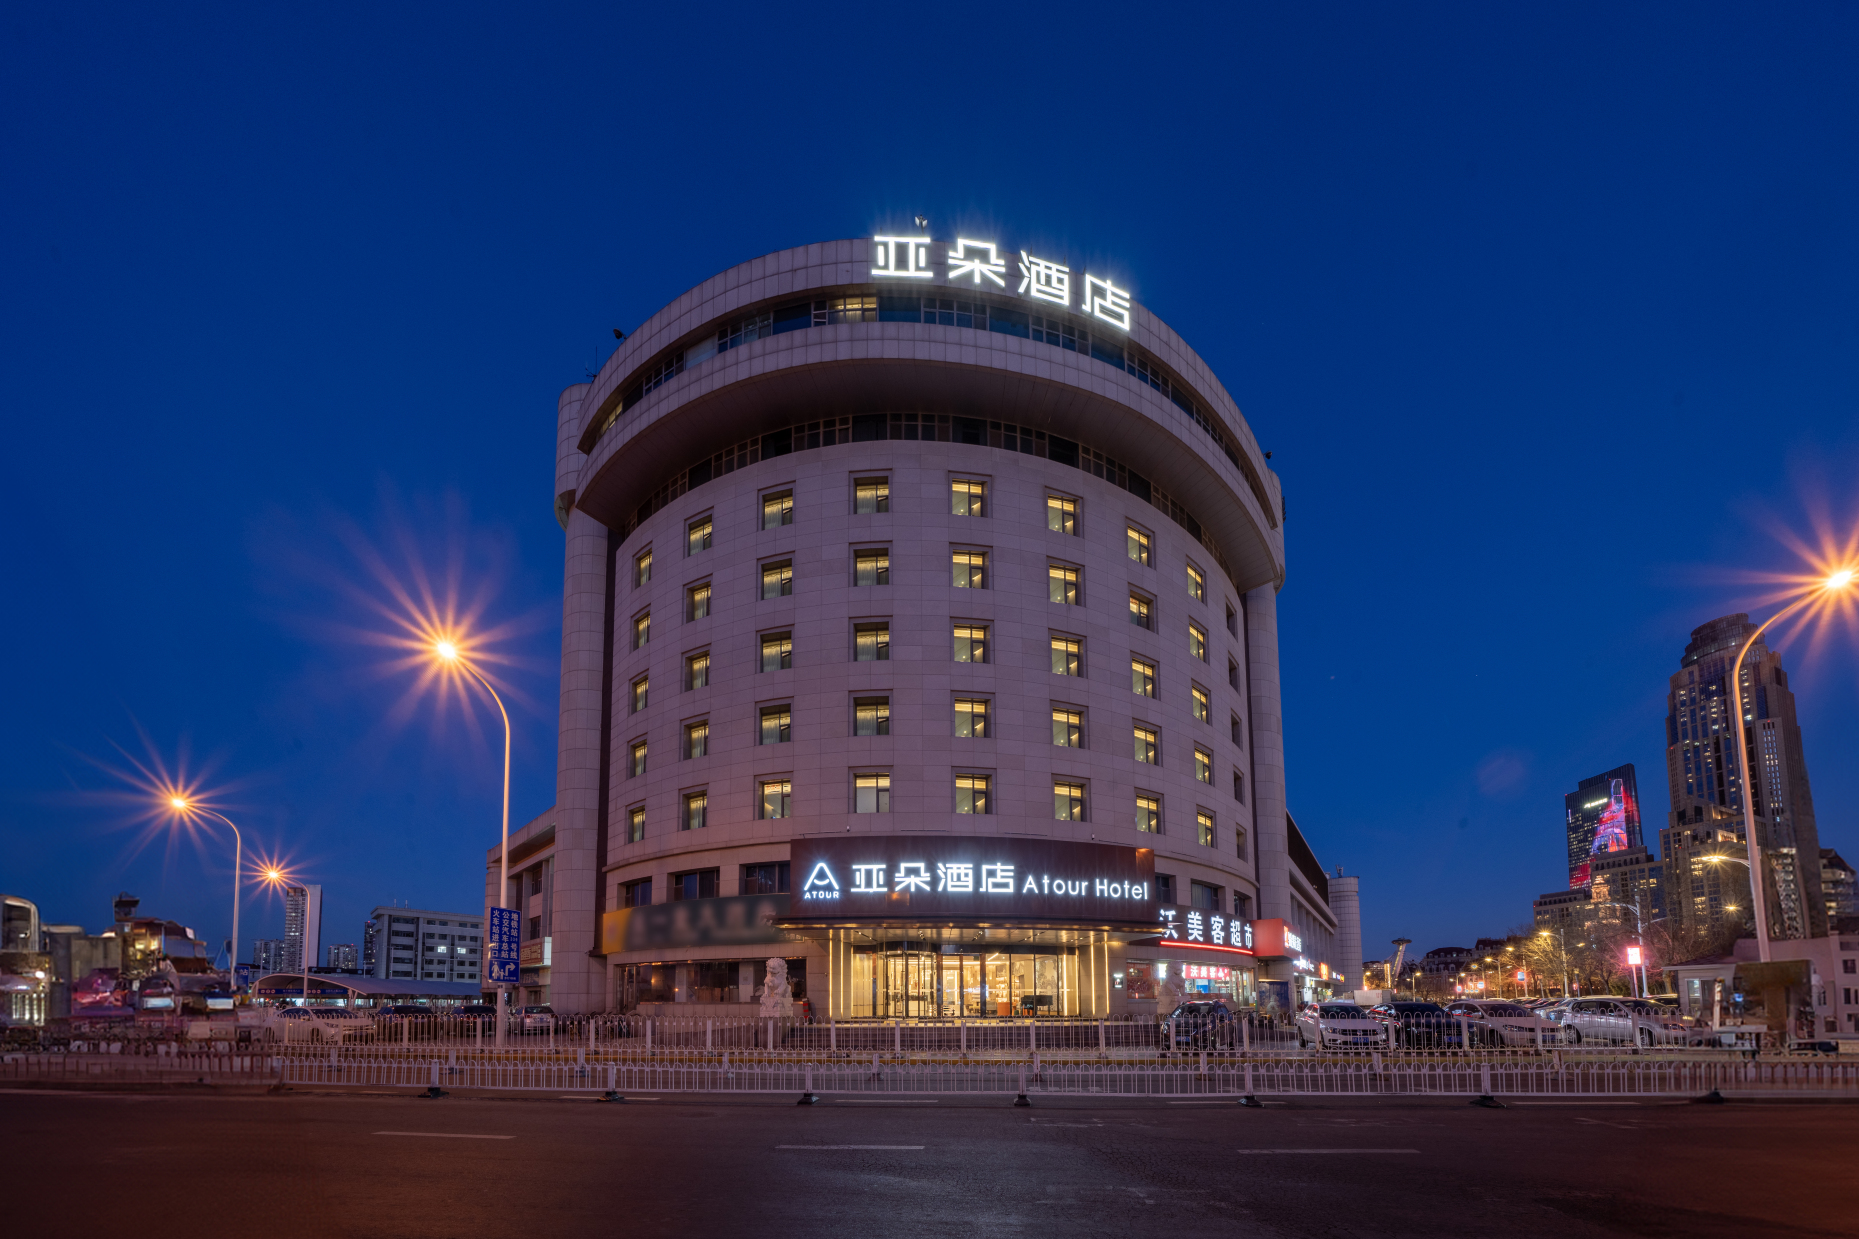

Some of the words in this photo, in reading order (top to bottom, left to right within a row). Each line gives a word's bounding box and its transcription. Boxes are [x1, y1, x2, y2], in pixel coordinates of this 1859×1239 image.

[871, 235, 1131, 331] 亚朵酒店
[850, 862, 1015, 893] 亚朵酒店
[1022, 874, 1089, 896] Atour
[1095, 878, 1149, 900] Hotel
[804, 890, 840, 899] ATOUR
